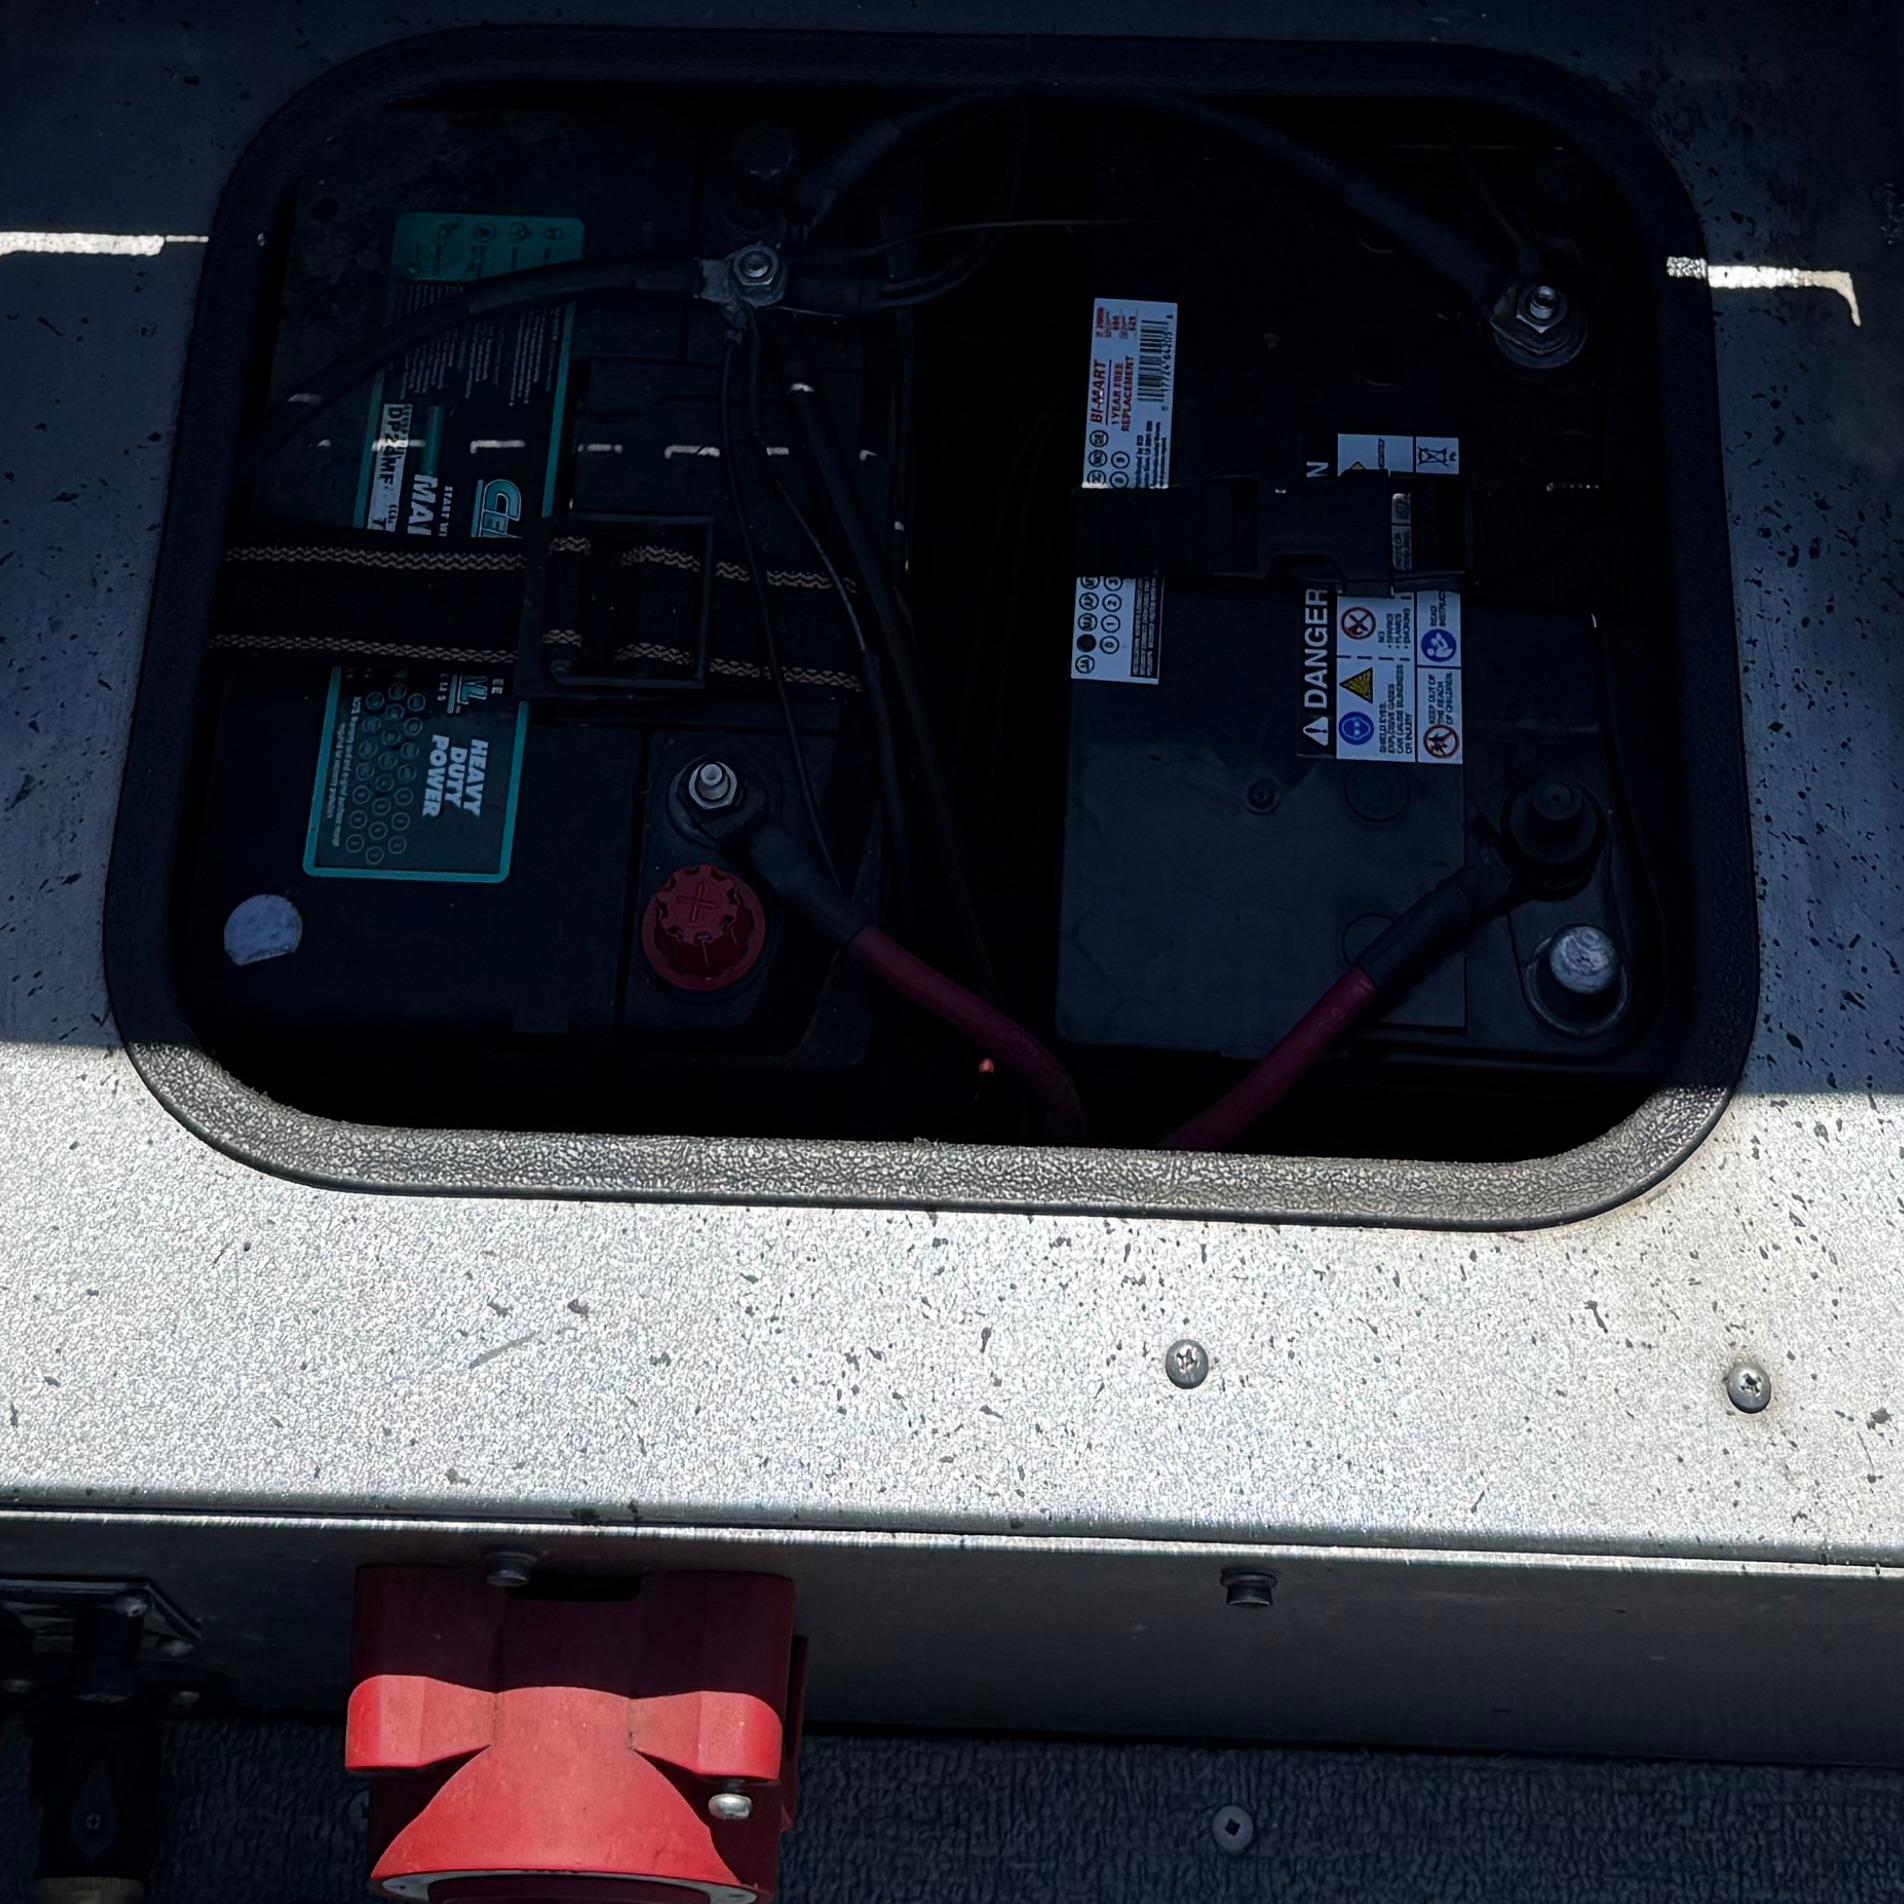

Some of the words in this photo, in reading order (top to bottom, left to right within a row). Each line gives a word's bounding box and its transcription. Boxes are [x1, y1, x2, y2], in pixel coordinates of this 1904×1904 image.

[1092, 360, 1106, 423] BI-MART
[1112, 362, 1123, 388] FREE
[1112, 390, 1122, 420] YEAR
[1121, 355, 1134, 432] REPLACEMENT
[1303, 587, 1329, 710] DANGER
[421, 734, 449, 817] POWER
[444, 746, 468, 809] DUTY
[462, 739, 489, 817] HEAVY
